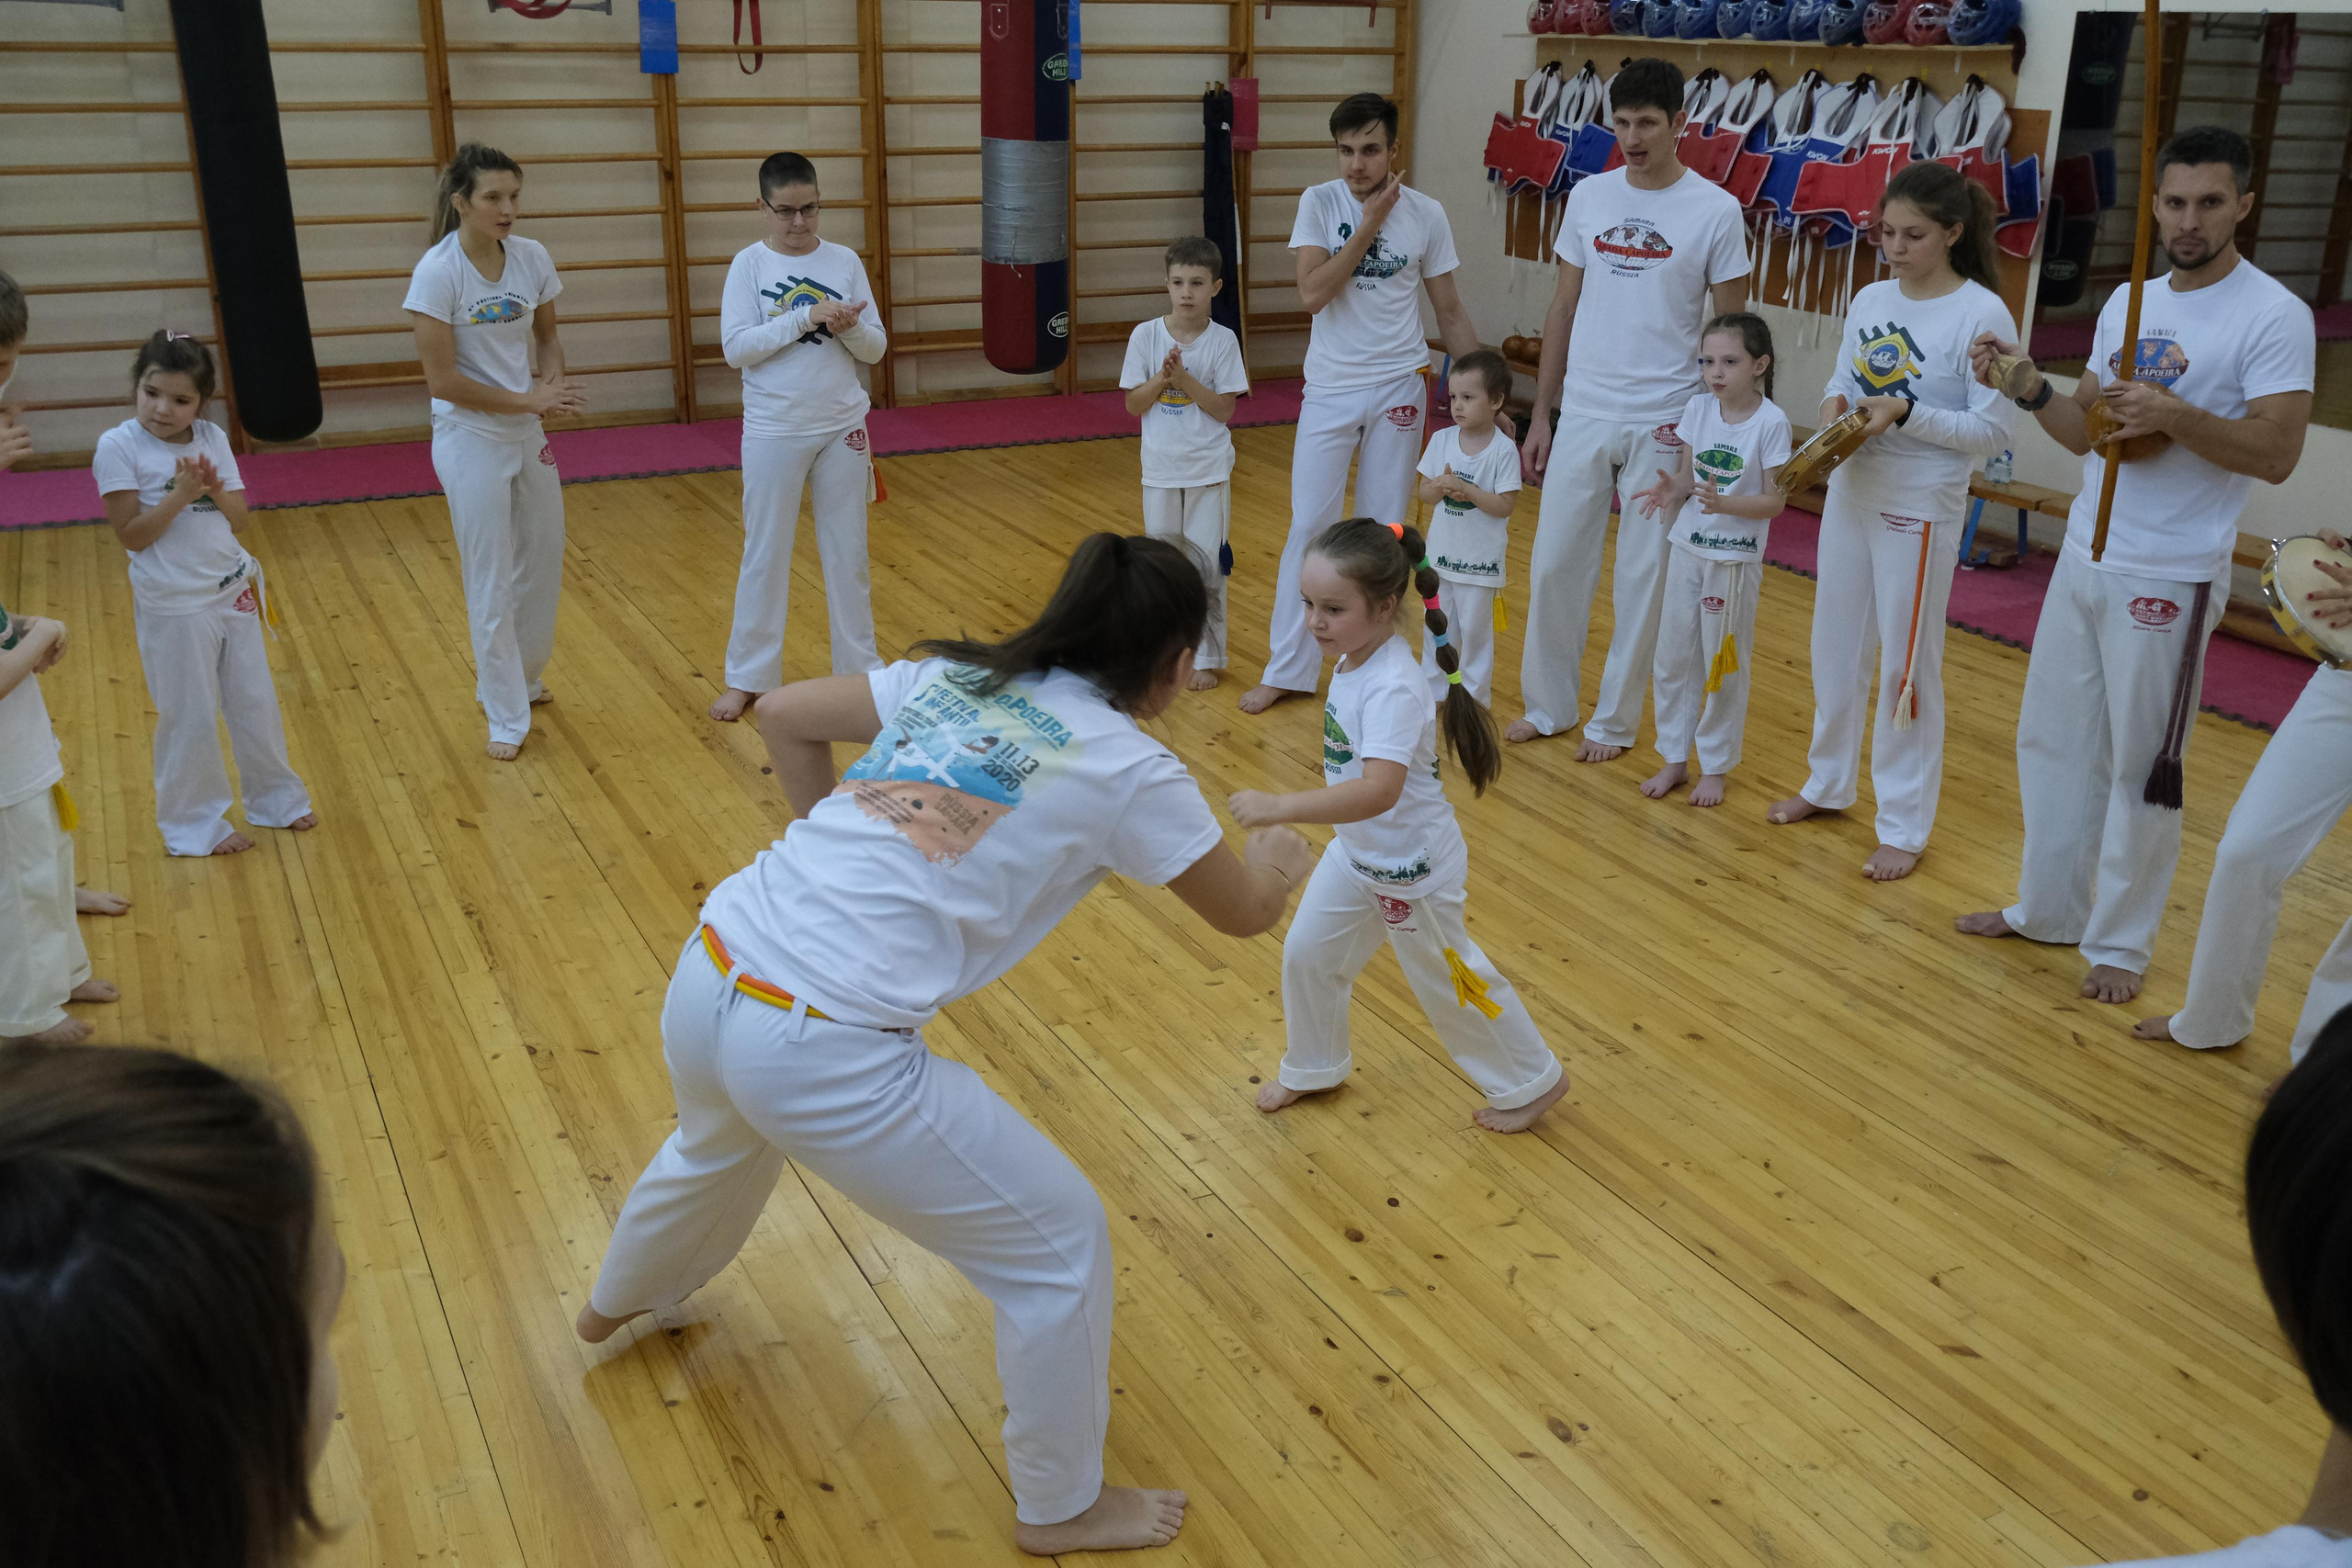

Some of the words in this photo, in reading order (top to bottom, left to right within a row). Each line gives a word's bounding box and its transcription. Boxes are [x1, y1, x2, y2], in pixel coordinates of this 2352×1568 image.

[1052, 68, 1067, 77] HILL
[1805, 150, 1829, 161] KWON
[1623, 217, 1656, 227] SAMARA
[1051, 316, 1069, 327] GREE
[1713, 443, 1738, 454] SAMARA
[993, 694, 1073, 748] APOEIRA
[980, 759, 1022, 793] 2020
